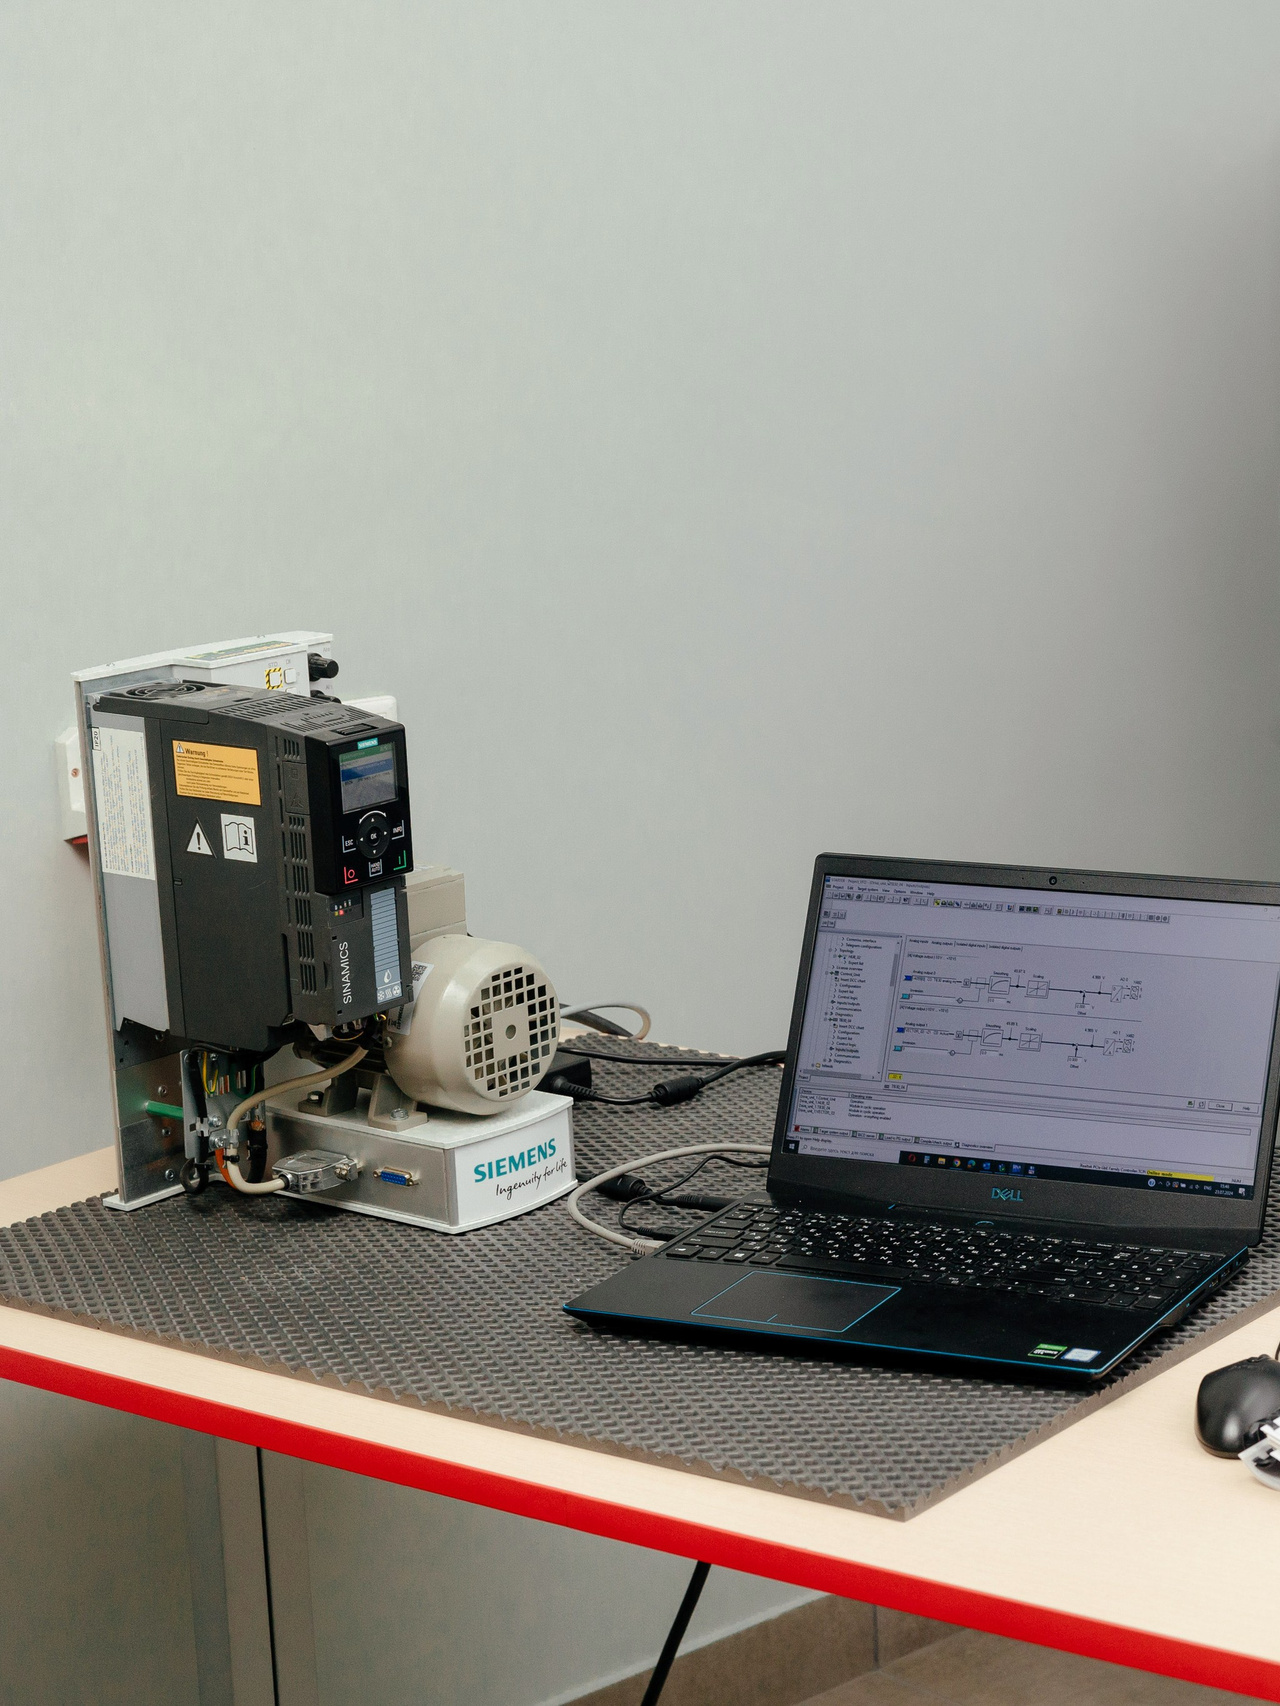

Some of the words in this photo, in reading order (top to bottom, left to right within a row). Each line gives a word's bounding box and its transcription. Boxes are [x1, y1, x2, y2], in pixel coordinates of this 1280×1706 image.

[185, 748, 205, 757] Warnung
[339, 942, 352, 1004] SINAMICS
[474, 1138, 556, 1183] SIEMENS
[496, 1171, 542, 1200] Ingenuity
[543, 1166, 554, 1181] for
[556, 1158, 568, 1173] life
[991, 1187, 1023, 1201] DELL
